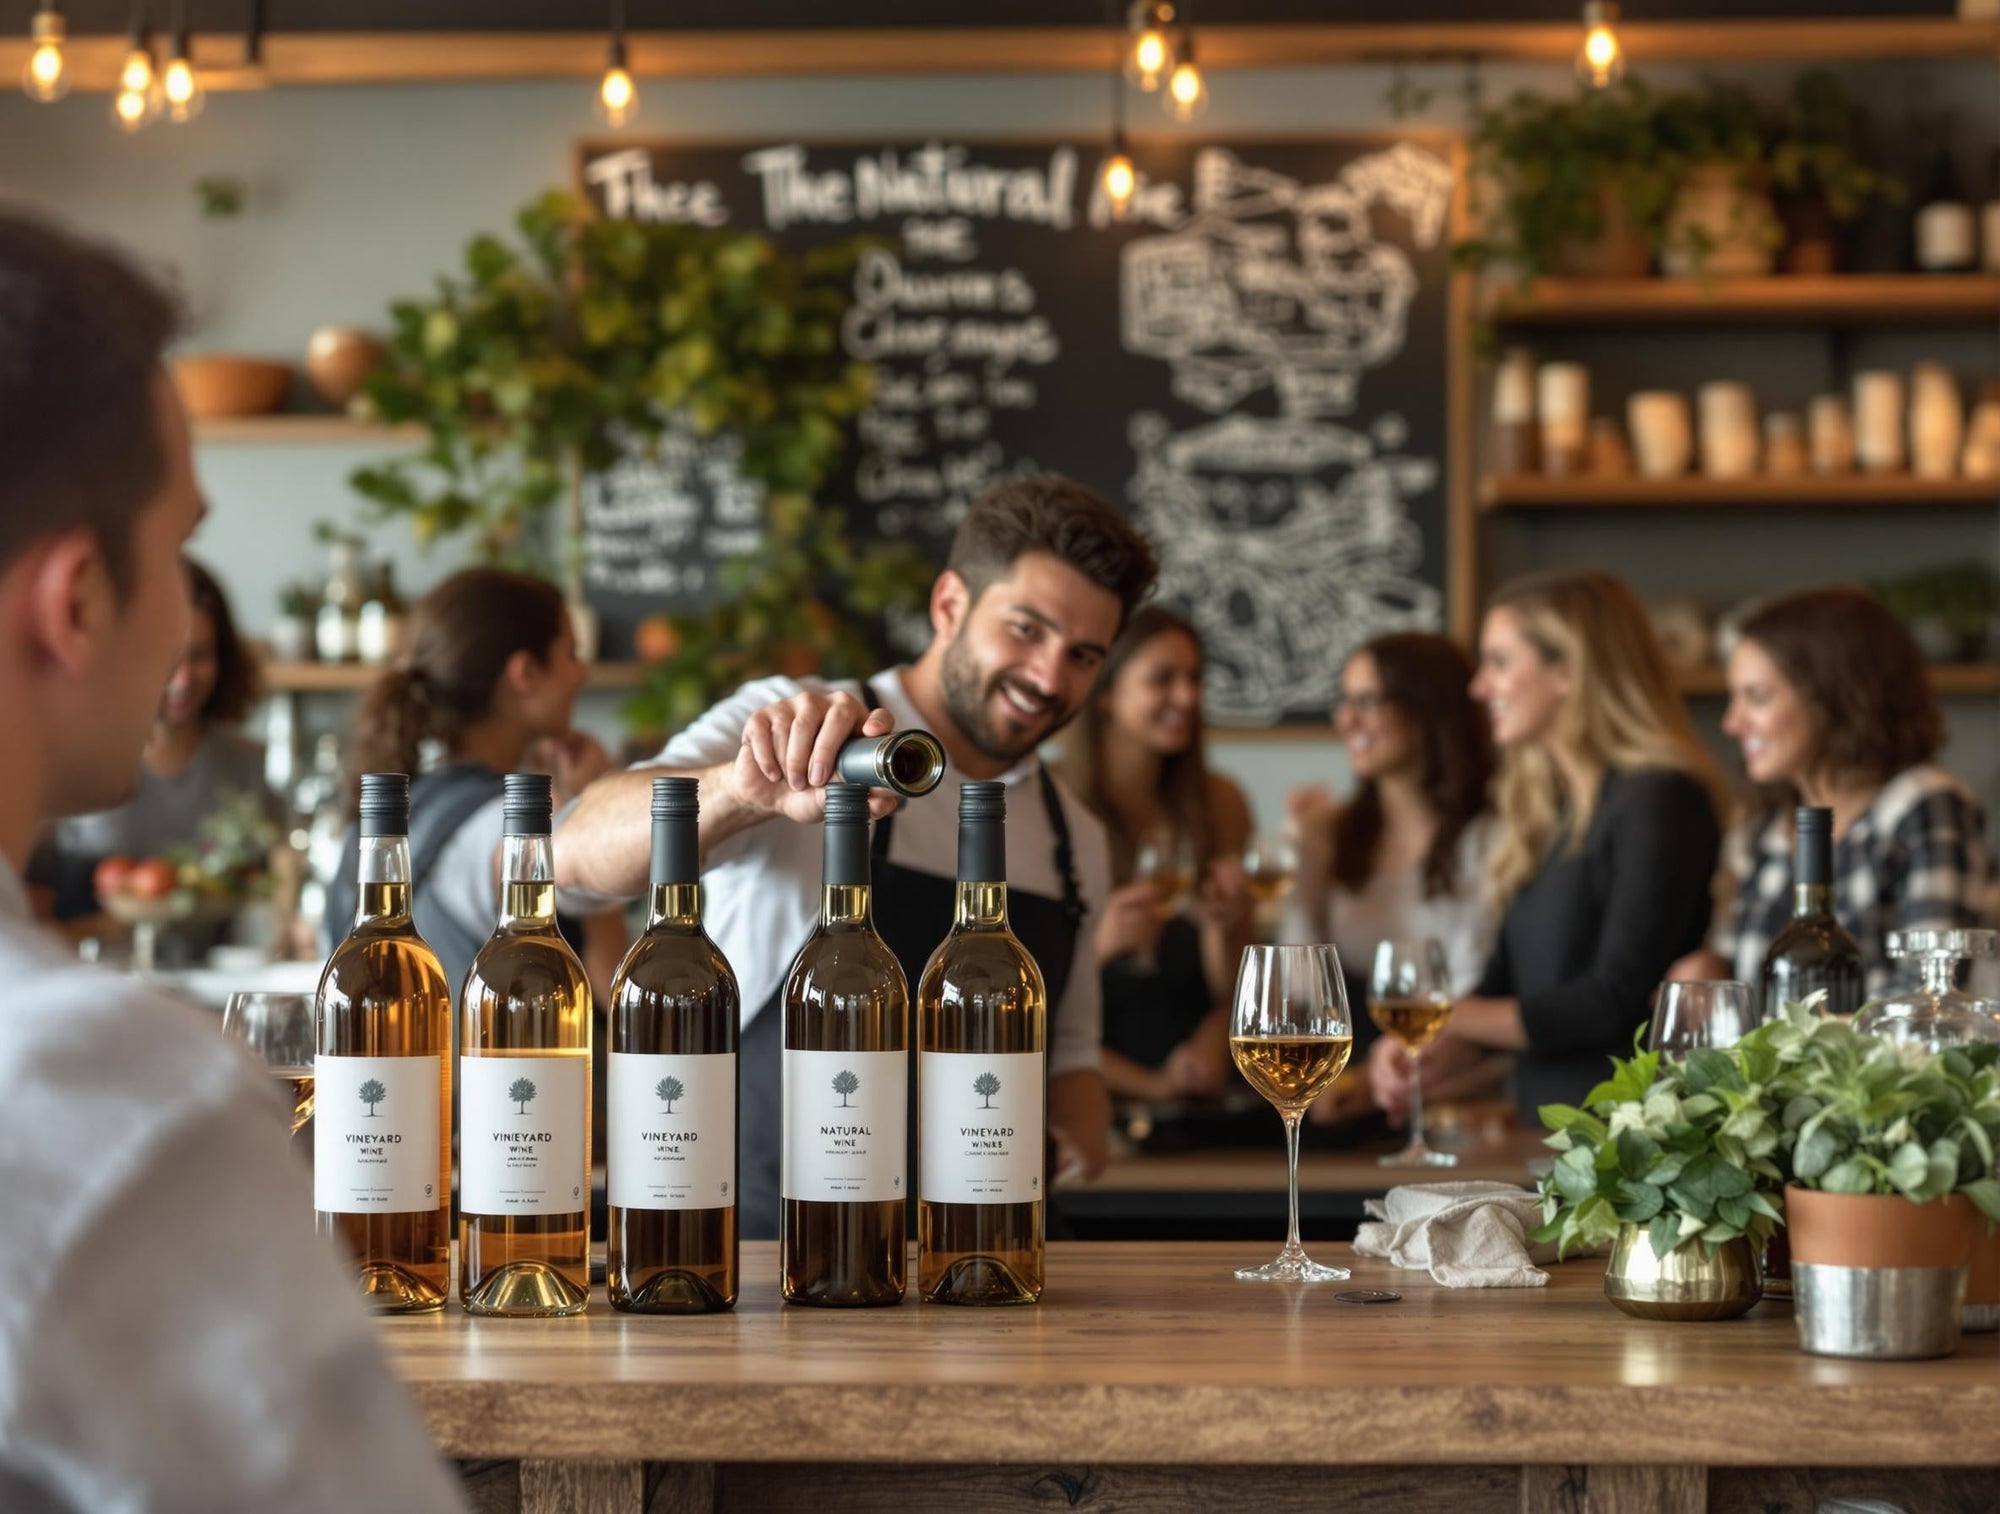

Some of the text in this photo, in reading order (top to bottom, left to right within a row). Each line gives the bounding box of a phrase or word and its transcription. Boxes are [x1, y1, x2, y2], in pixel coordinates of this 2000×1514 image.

[741, 145, 853, 232] The
[854, 143, 1078, 231] Natural
[820, 1126, 872, 1136] NATURAL
[960, 1127, 1014, 1137] VINEYARD
[345, 1134, 402, 1144] VINEYARD
[641, 1132, 698, 1142] VINEYARD
[833, 1139, 856, 1147] WINE
[360, 1147, 384, 1155] WINE
[509, 1145, 533, 1154] WINE
[657, 1145, 680, 1153] WINE
